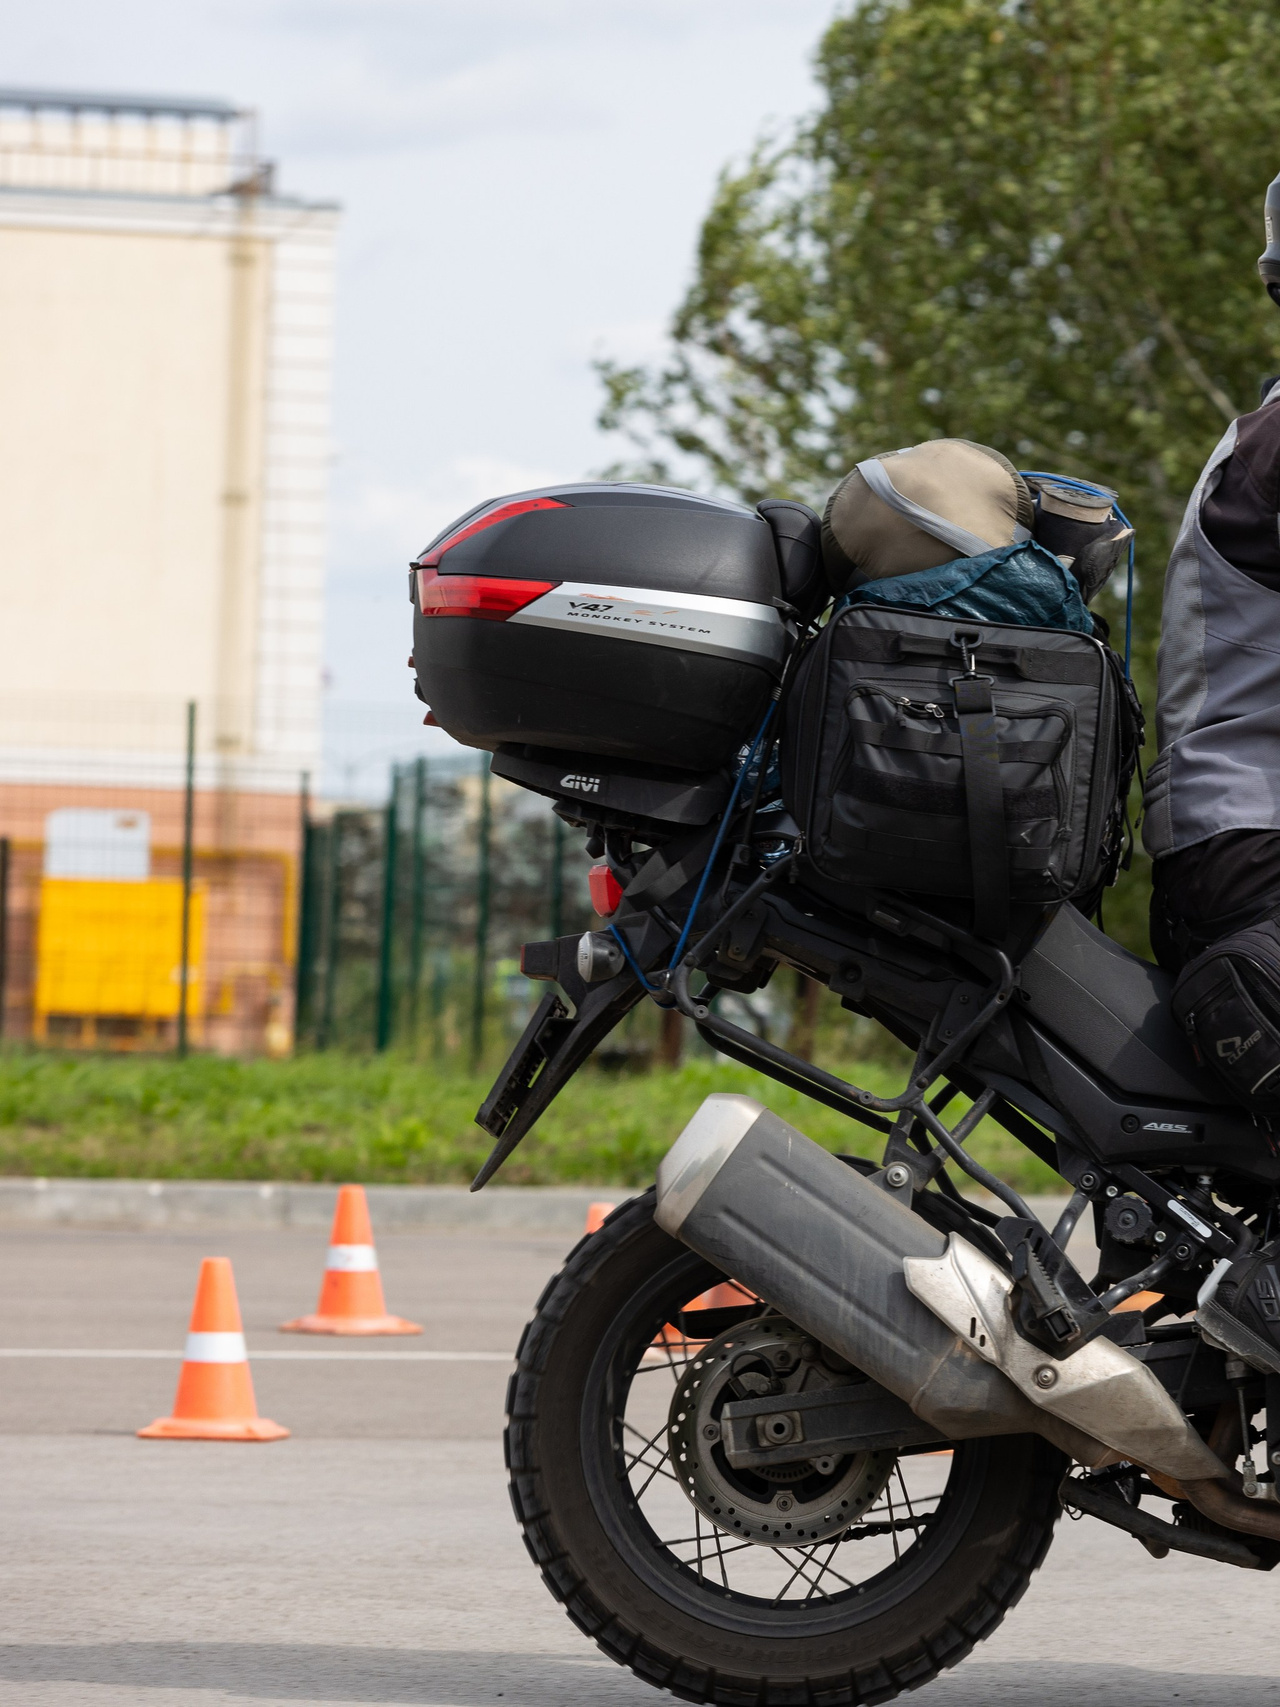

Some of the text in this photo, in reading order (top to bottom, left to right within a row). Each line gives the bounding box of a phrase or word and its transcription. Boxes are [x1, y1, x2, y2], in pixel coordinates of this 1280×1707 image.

[568, 601, 614, 613] V47
[567, 611, 711, 634] MONOKEY SYSTEM
[560, 774, 601, 793] GIVI
[1142, 1122, 1189, 1131] ABS
